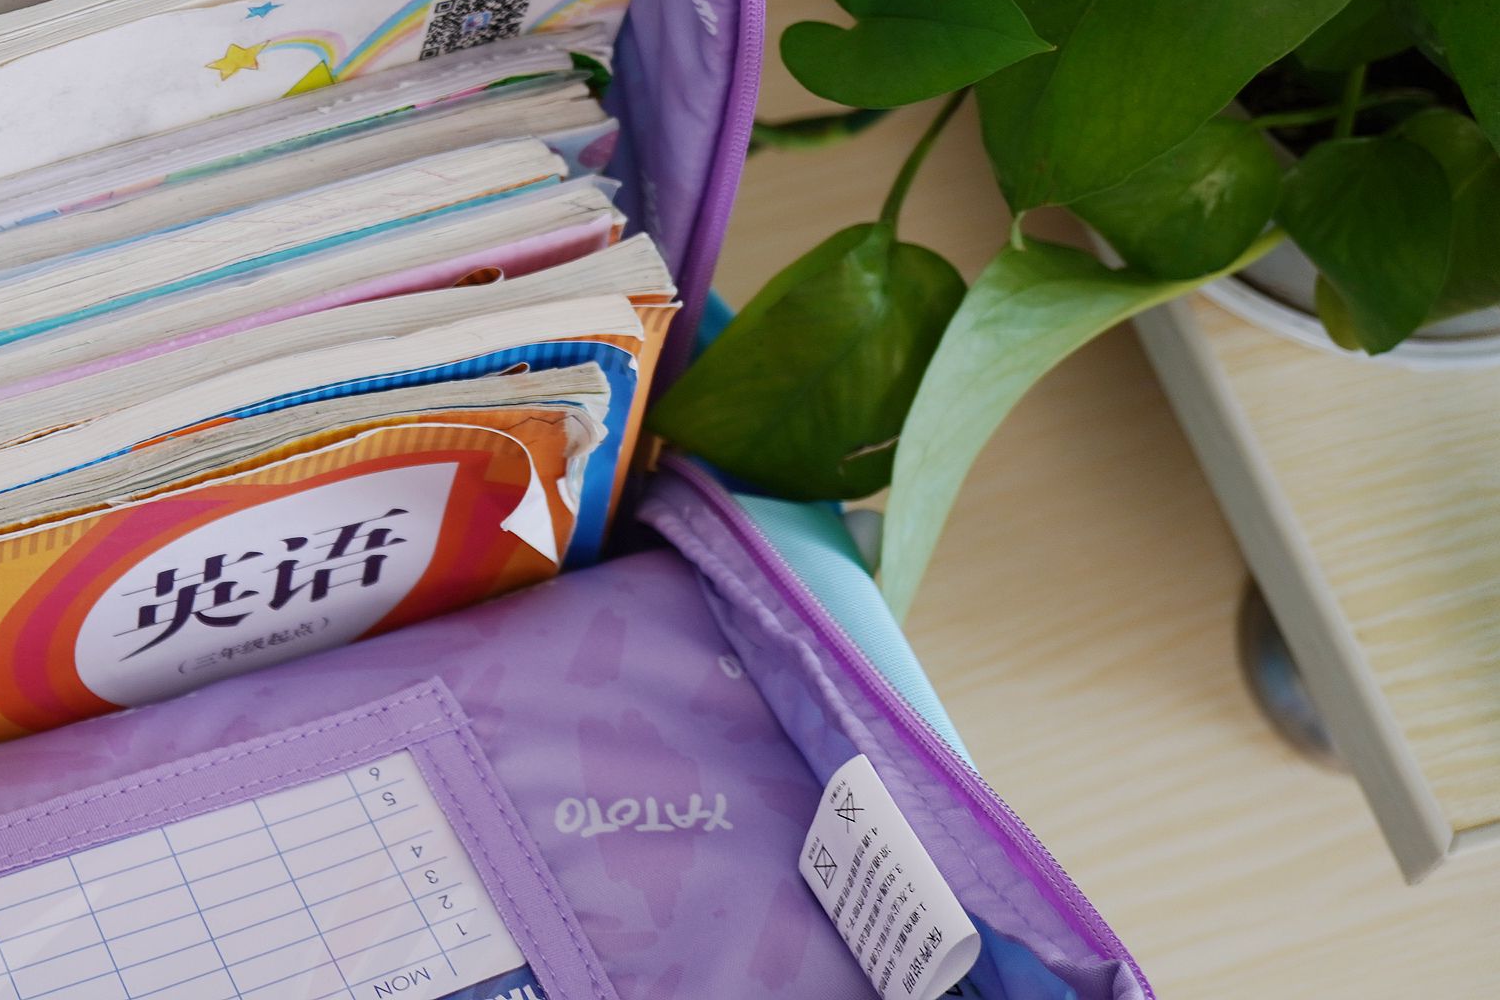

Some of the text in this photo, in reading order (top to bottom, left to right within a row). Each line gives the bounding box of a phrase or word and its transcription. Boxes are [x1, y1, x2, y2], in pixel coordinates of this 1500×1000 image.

[112, 508, 410, 662] 英语
[368, 767, 381, 781] 6
[381, 791, 397, 807] 5
[411, 845, 423, 859] 4
[424, 869, 439, 885] 3
[438, 894, 453, 910] 2
[456, 922, 468, 937] 1
[373, 966, 432, 999] MON
